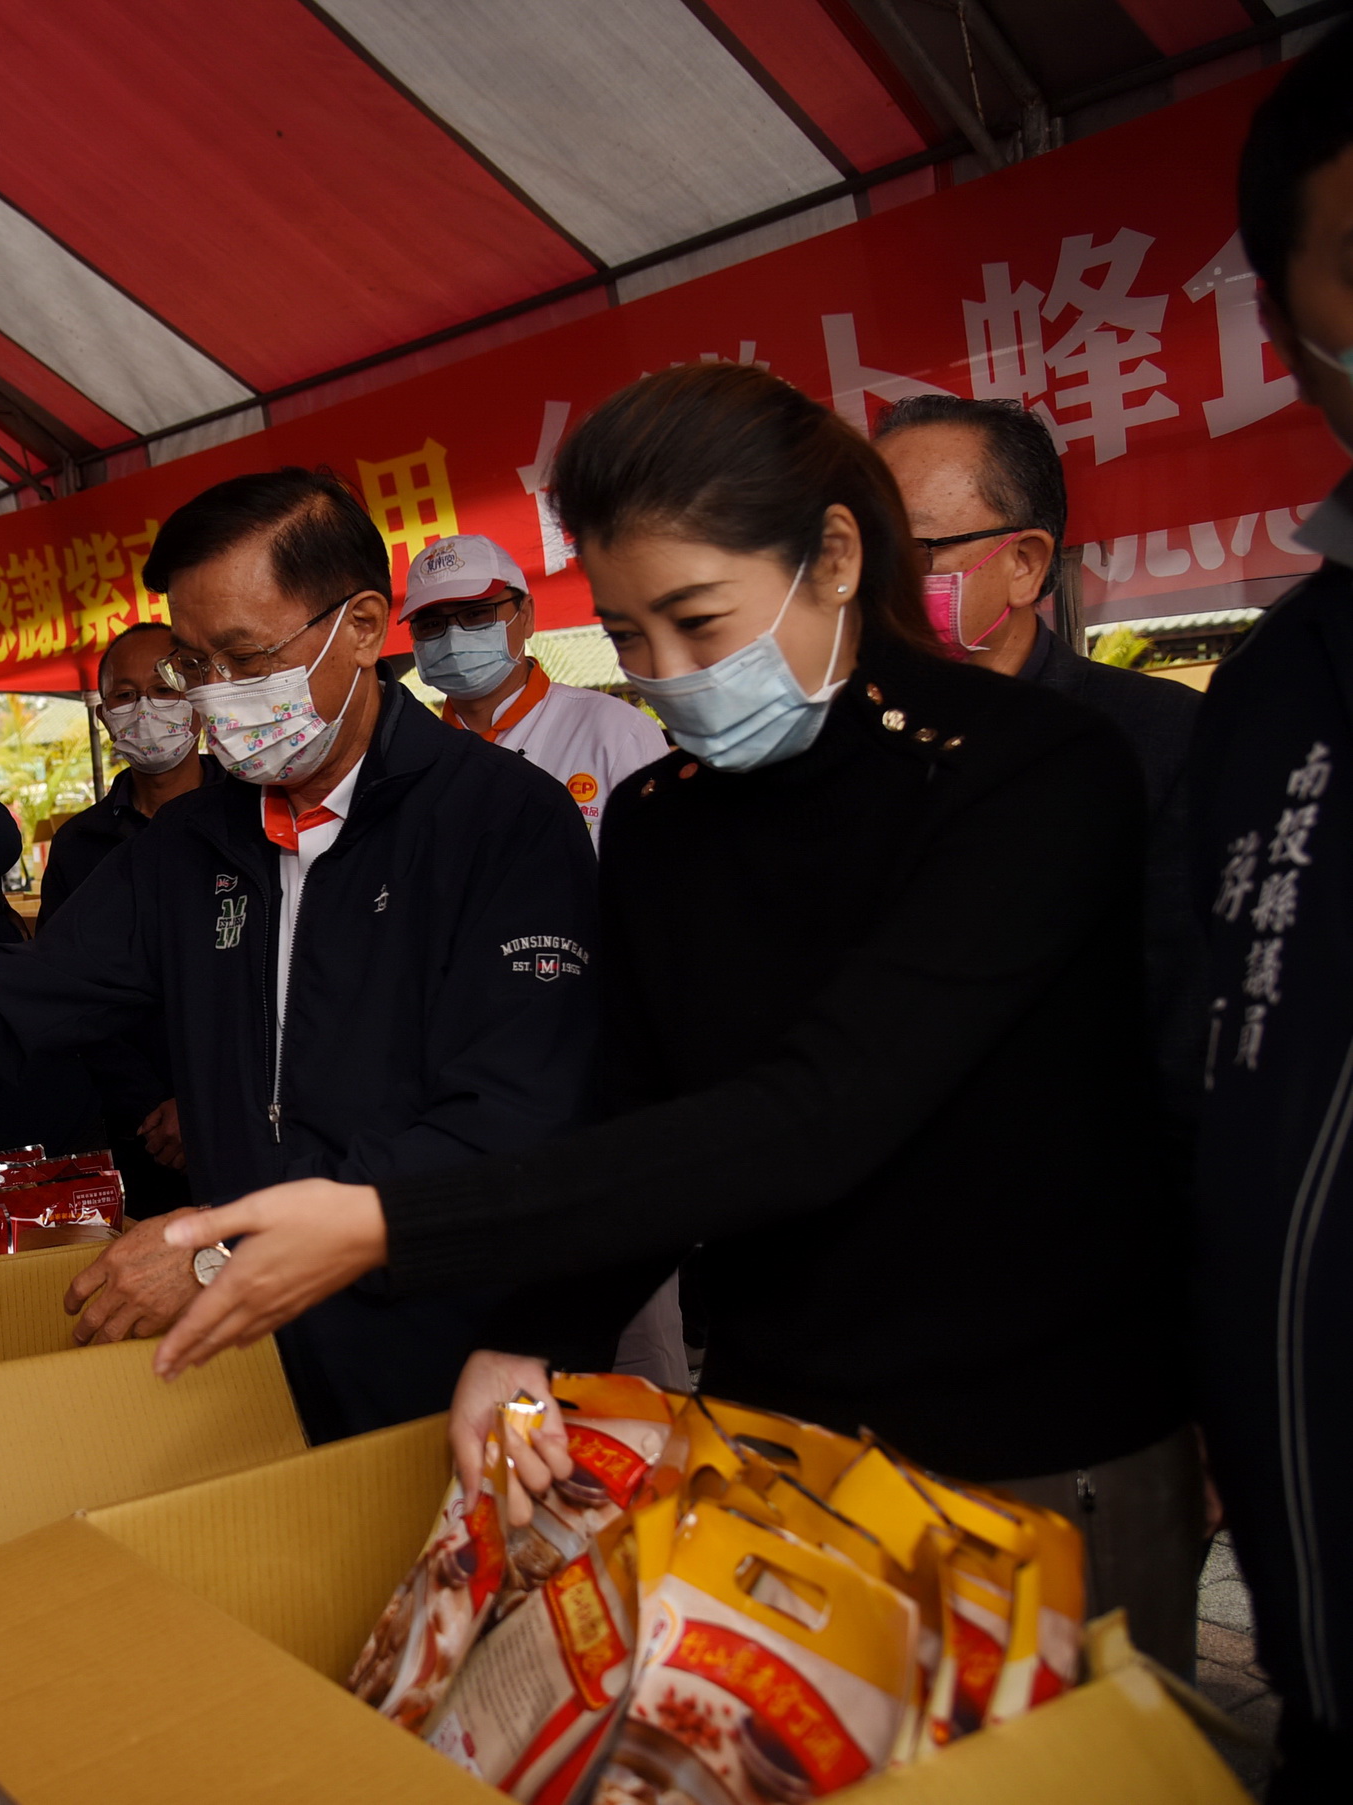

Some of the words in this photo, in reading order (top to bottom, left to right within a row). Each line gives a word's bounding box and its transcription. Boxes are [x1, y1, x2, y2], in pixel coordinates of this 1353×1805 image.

[569, 782, 594, 794] CP
[580, 805, 599, 817] 食品
[1232, 740, 1334, 1073] 南投縣議員
[499, 935, 590, 965] MUNSINGWEAR
[511, 961, 533, 972] EST.
[540, 959, 556, 974] M
[561, 962, 582, 976] 1955
